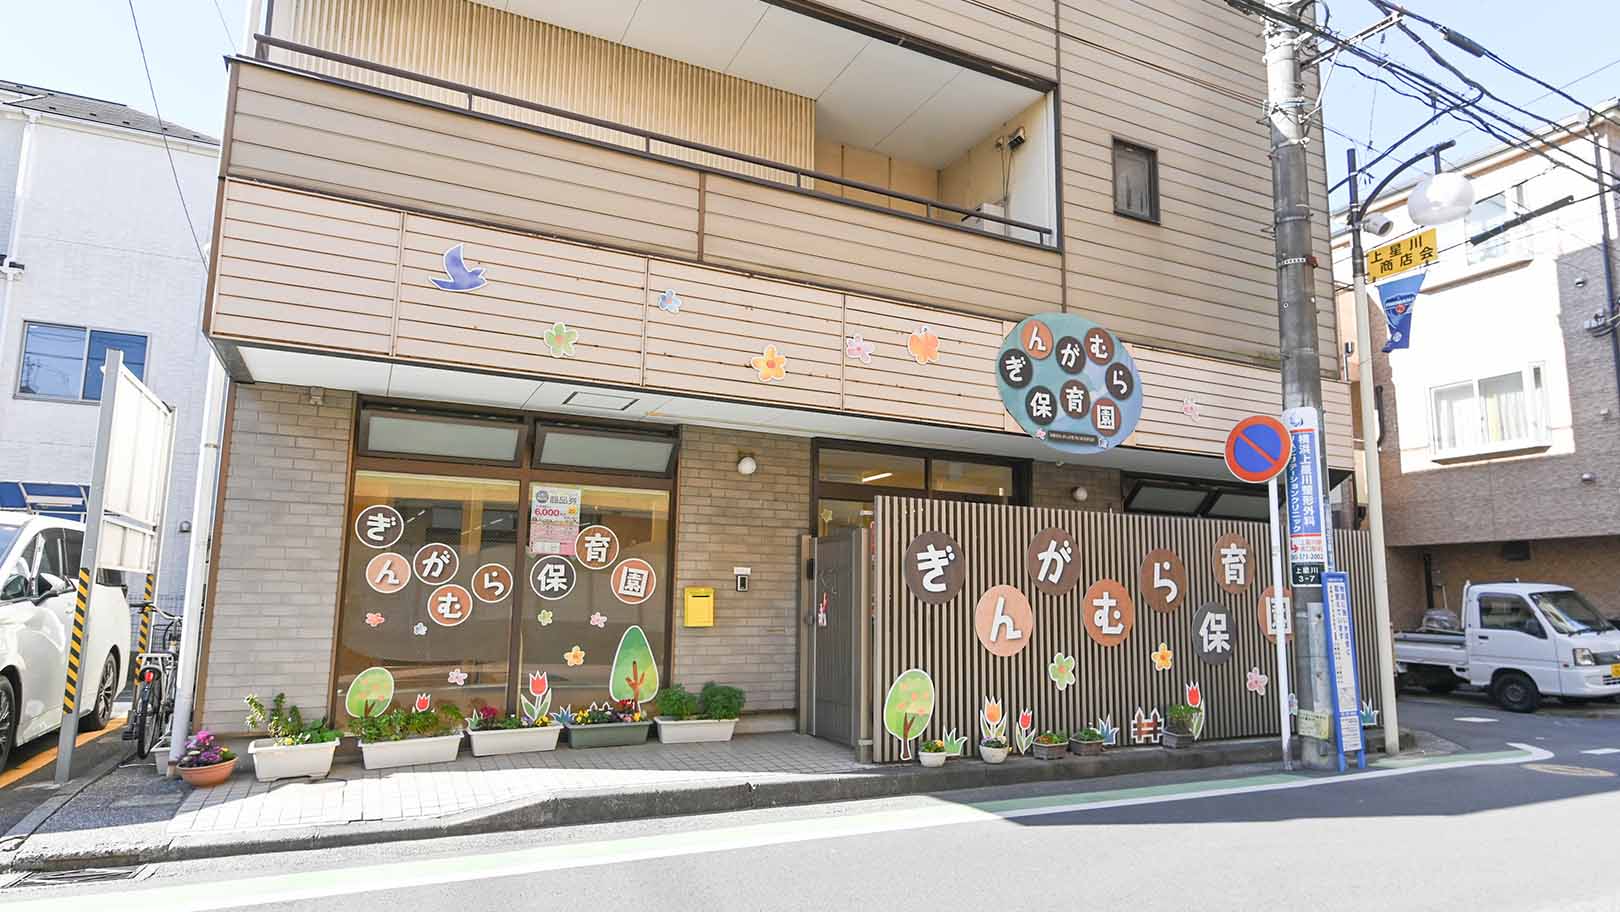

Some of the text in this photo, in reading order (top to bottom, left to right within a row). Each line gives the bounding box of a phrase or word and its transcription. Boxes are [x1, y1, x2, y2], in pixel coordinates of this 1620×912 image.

[1370, 236, 1424, 264] 上星川
[1380, 247, 1433, 273] 商店会
[1029, 385, 1115, 430] 保育園
[536, 532, 650, 599] 保育園
[1298, 575, 1316, 583] 3-7
